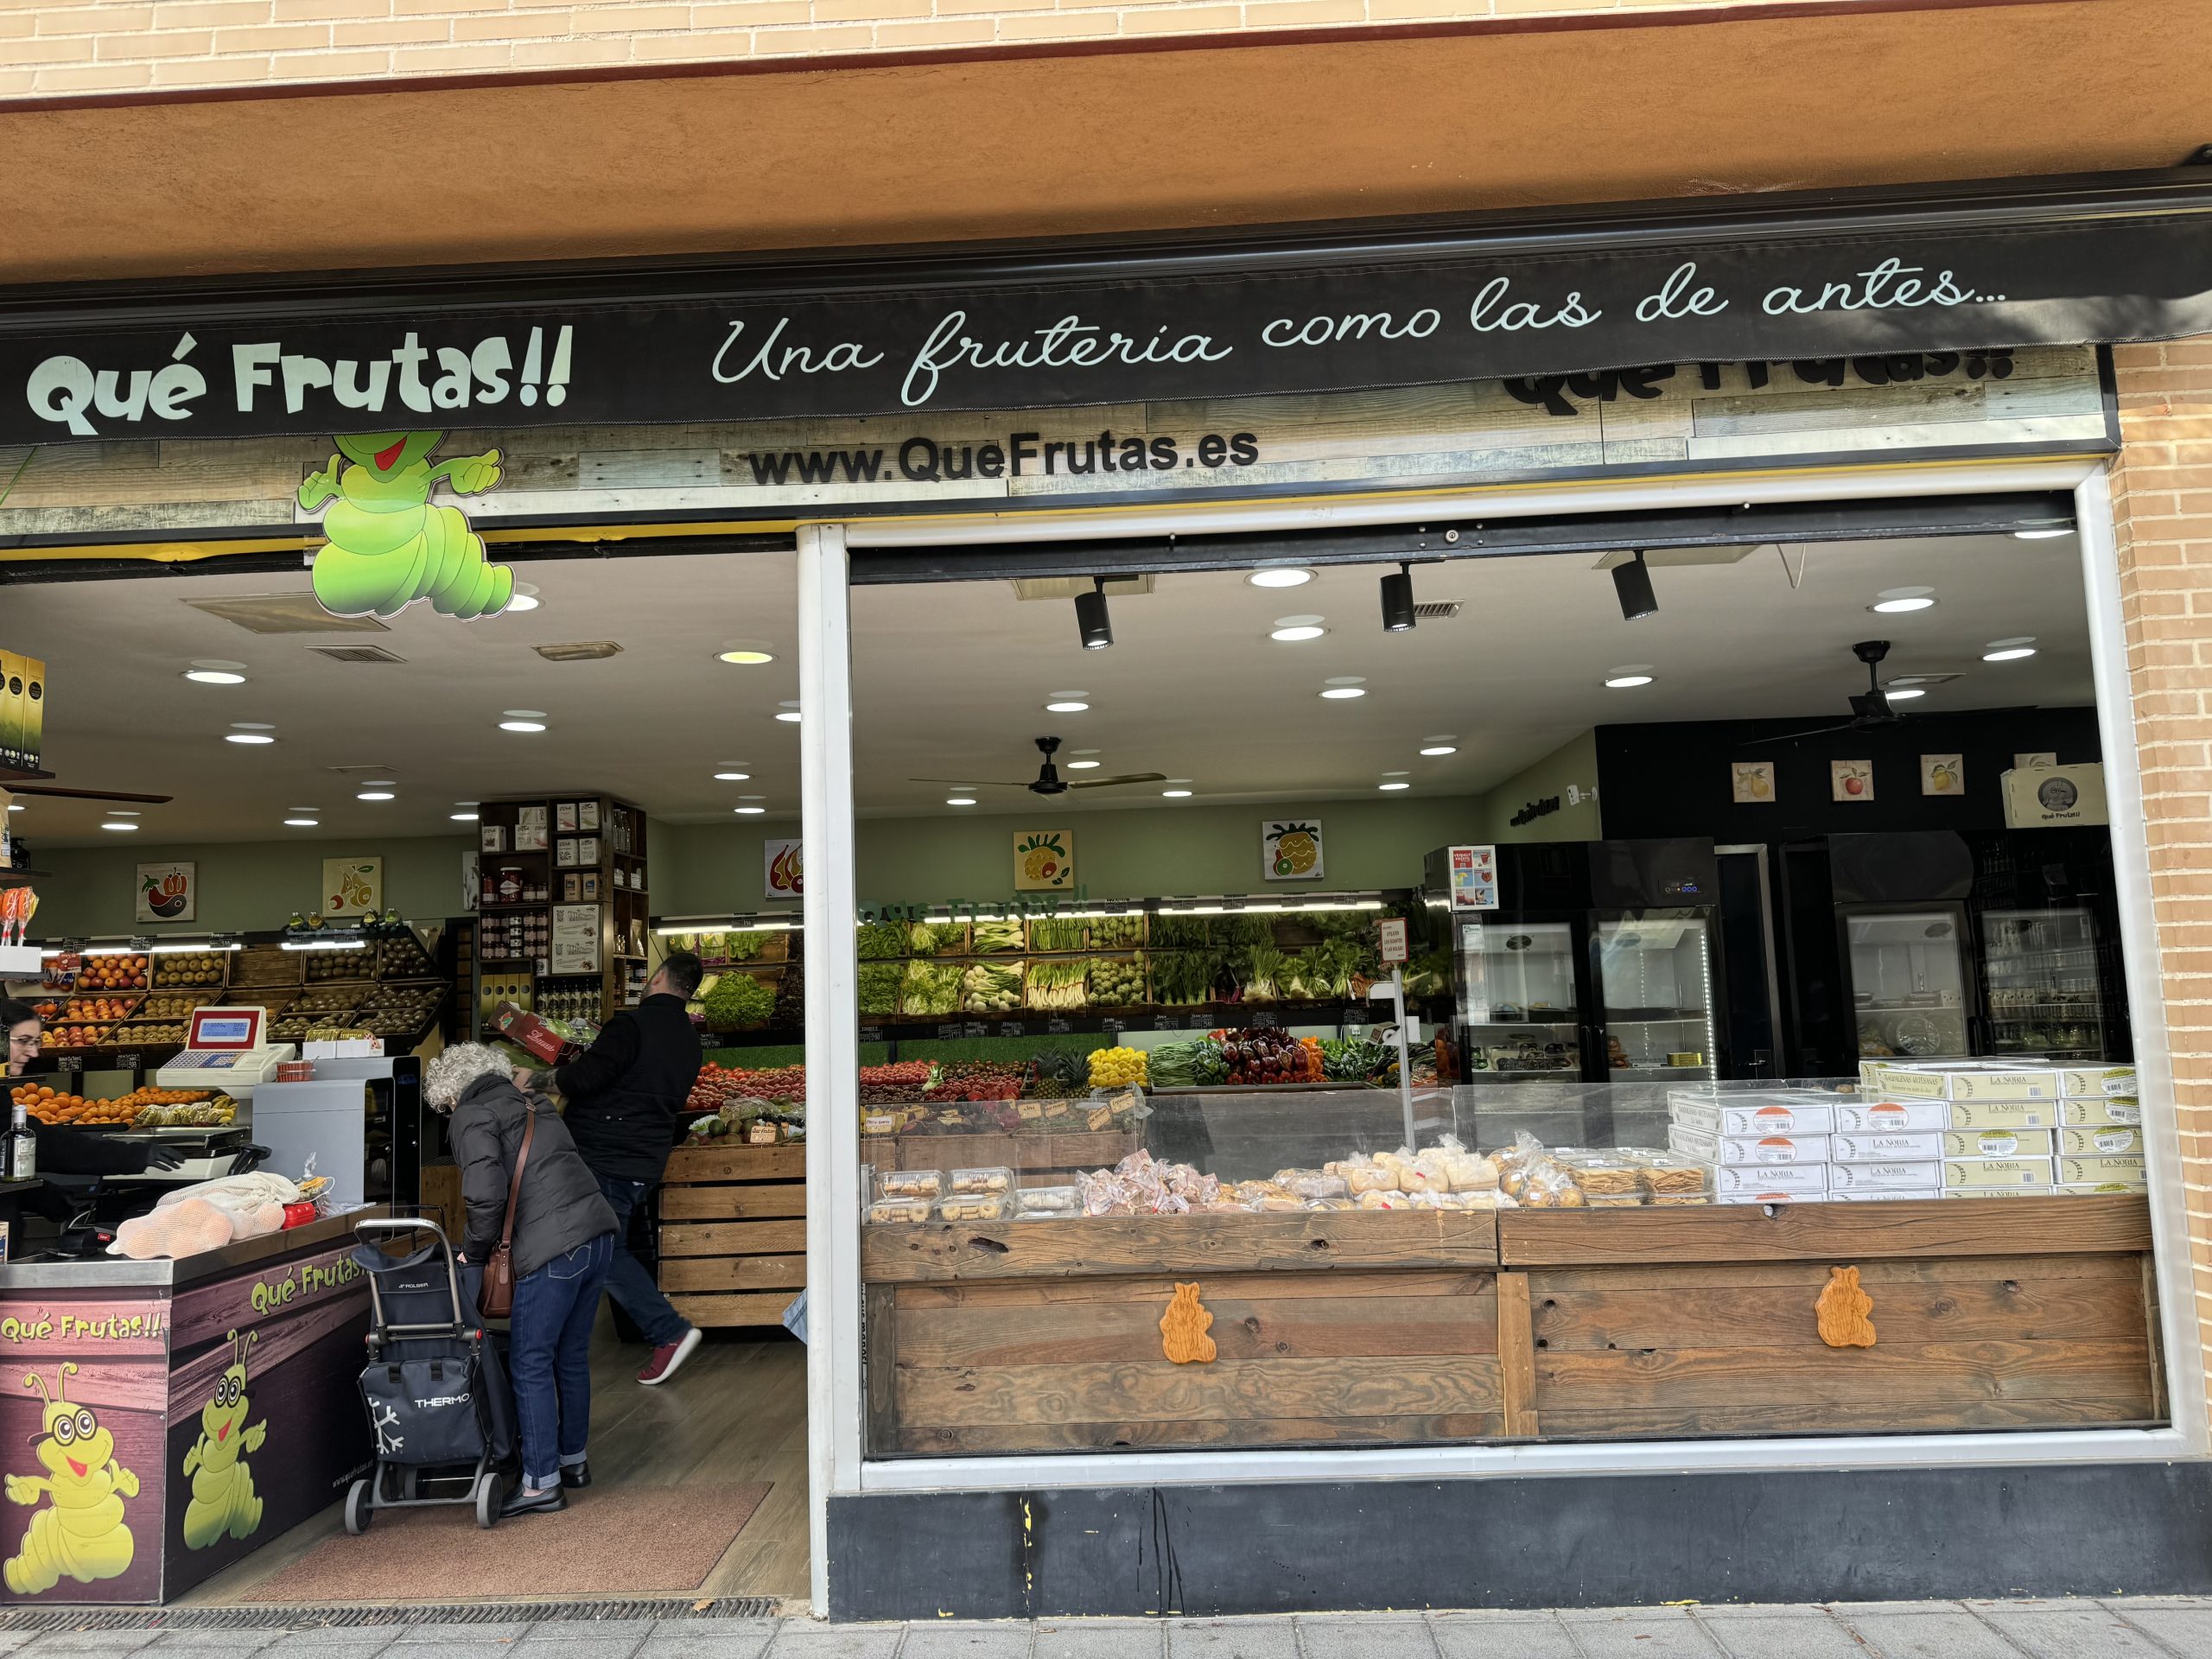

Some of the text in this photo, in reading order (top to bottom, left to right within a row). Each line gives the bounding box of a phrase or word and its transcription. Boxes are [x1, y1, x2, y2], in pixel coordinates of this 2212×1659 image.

[713, 318, 884, 383] Una
[1262, 309, 1440, 346] como
[1471, 277, 1602, 331] las
[1636, 263, 1728, 321] de
[1762, 257, 2006, 316] antes...
[27, 326, 572, 435] Qué Frutas!!
[748, 429, 1260, 486] www.QueFrutas.es
[251, 1252, 369, 1317] Qué Frutas
[1, 1312, 162, 1344] Qué Frutas!!
[414, 1393, 470, 1408] THERMO
